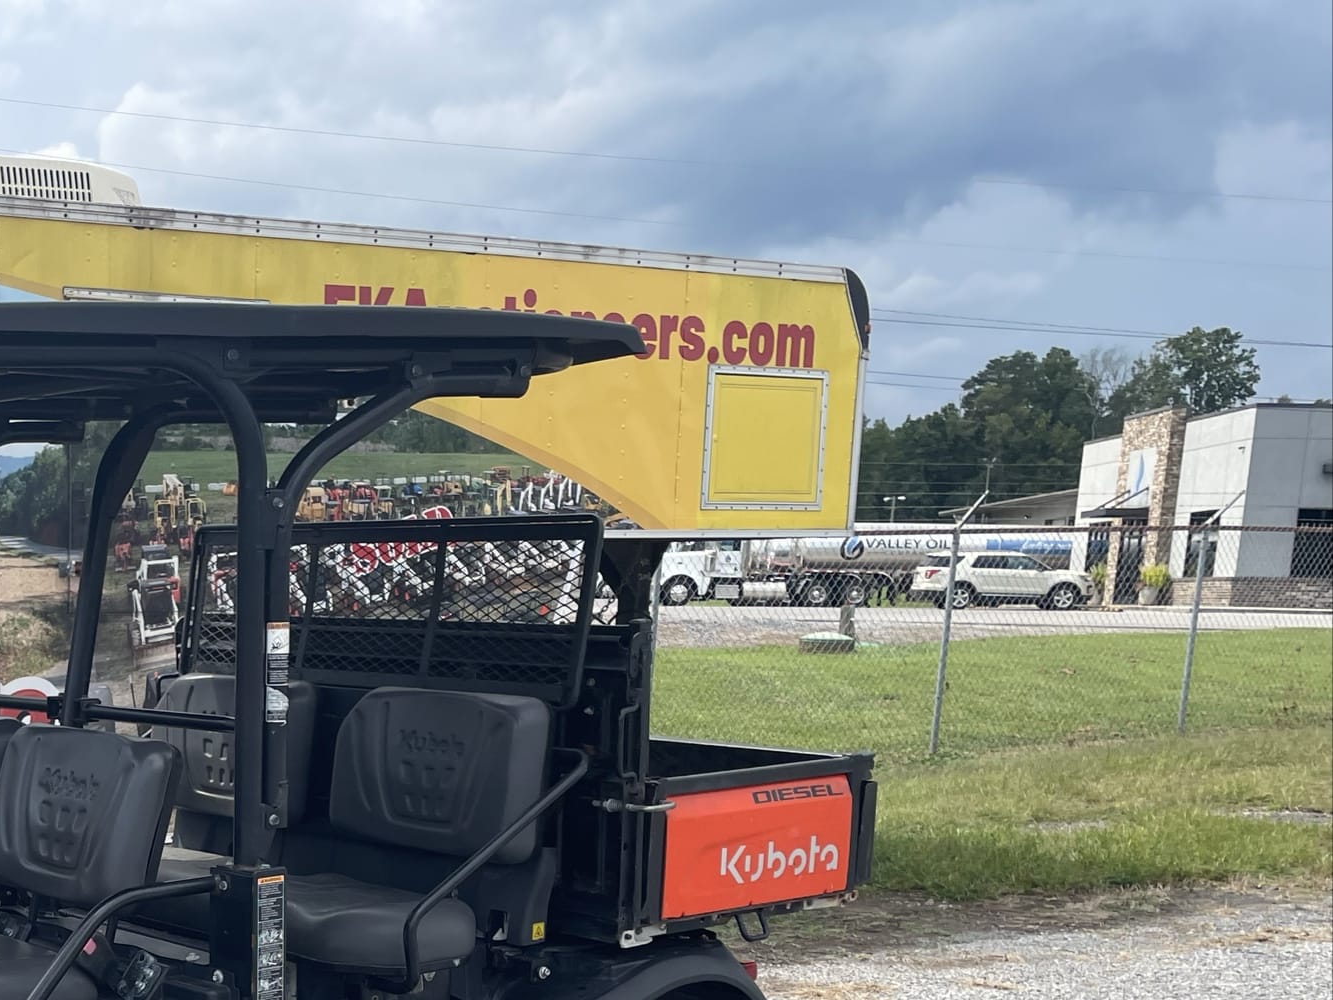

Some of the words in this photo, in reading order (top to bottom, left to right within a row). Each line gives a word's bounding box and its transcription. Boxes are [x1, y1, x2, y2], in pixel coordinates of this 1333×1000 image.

[865, 537, 922, 550] VALLEY
[926, 538, 951, 551] OIL
[751, 783, 844, 805] DIESEL
[719, 835, 839, 885] Kubota
